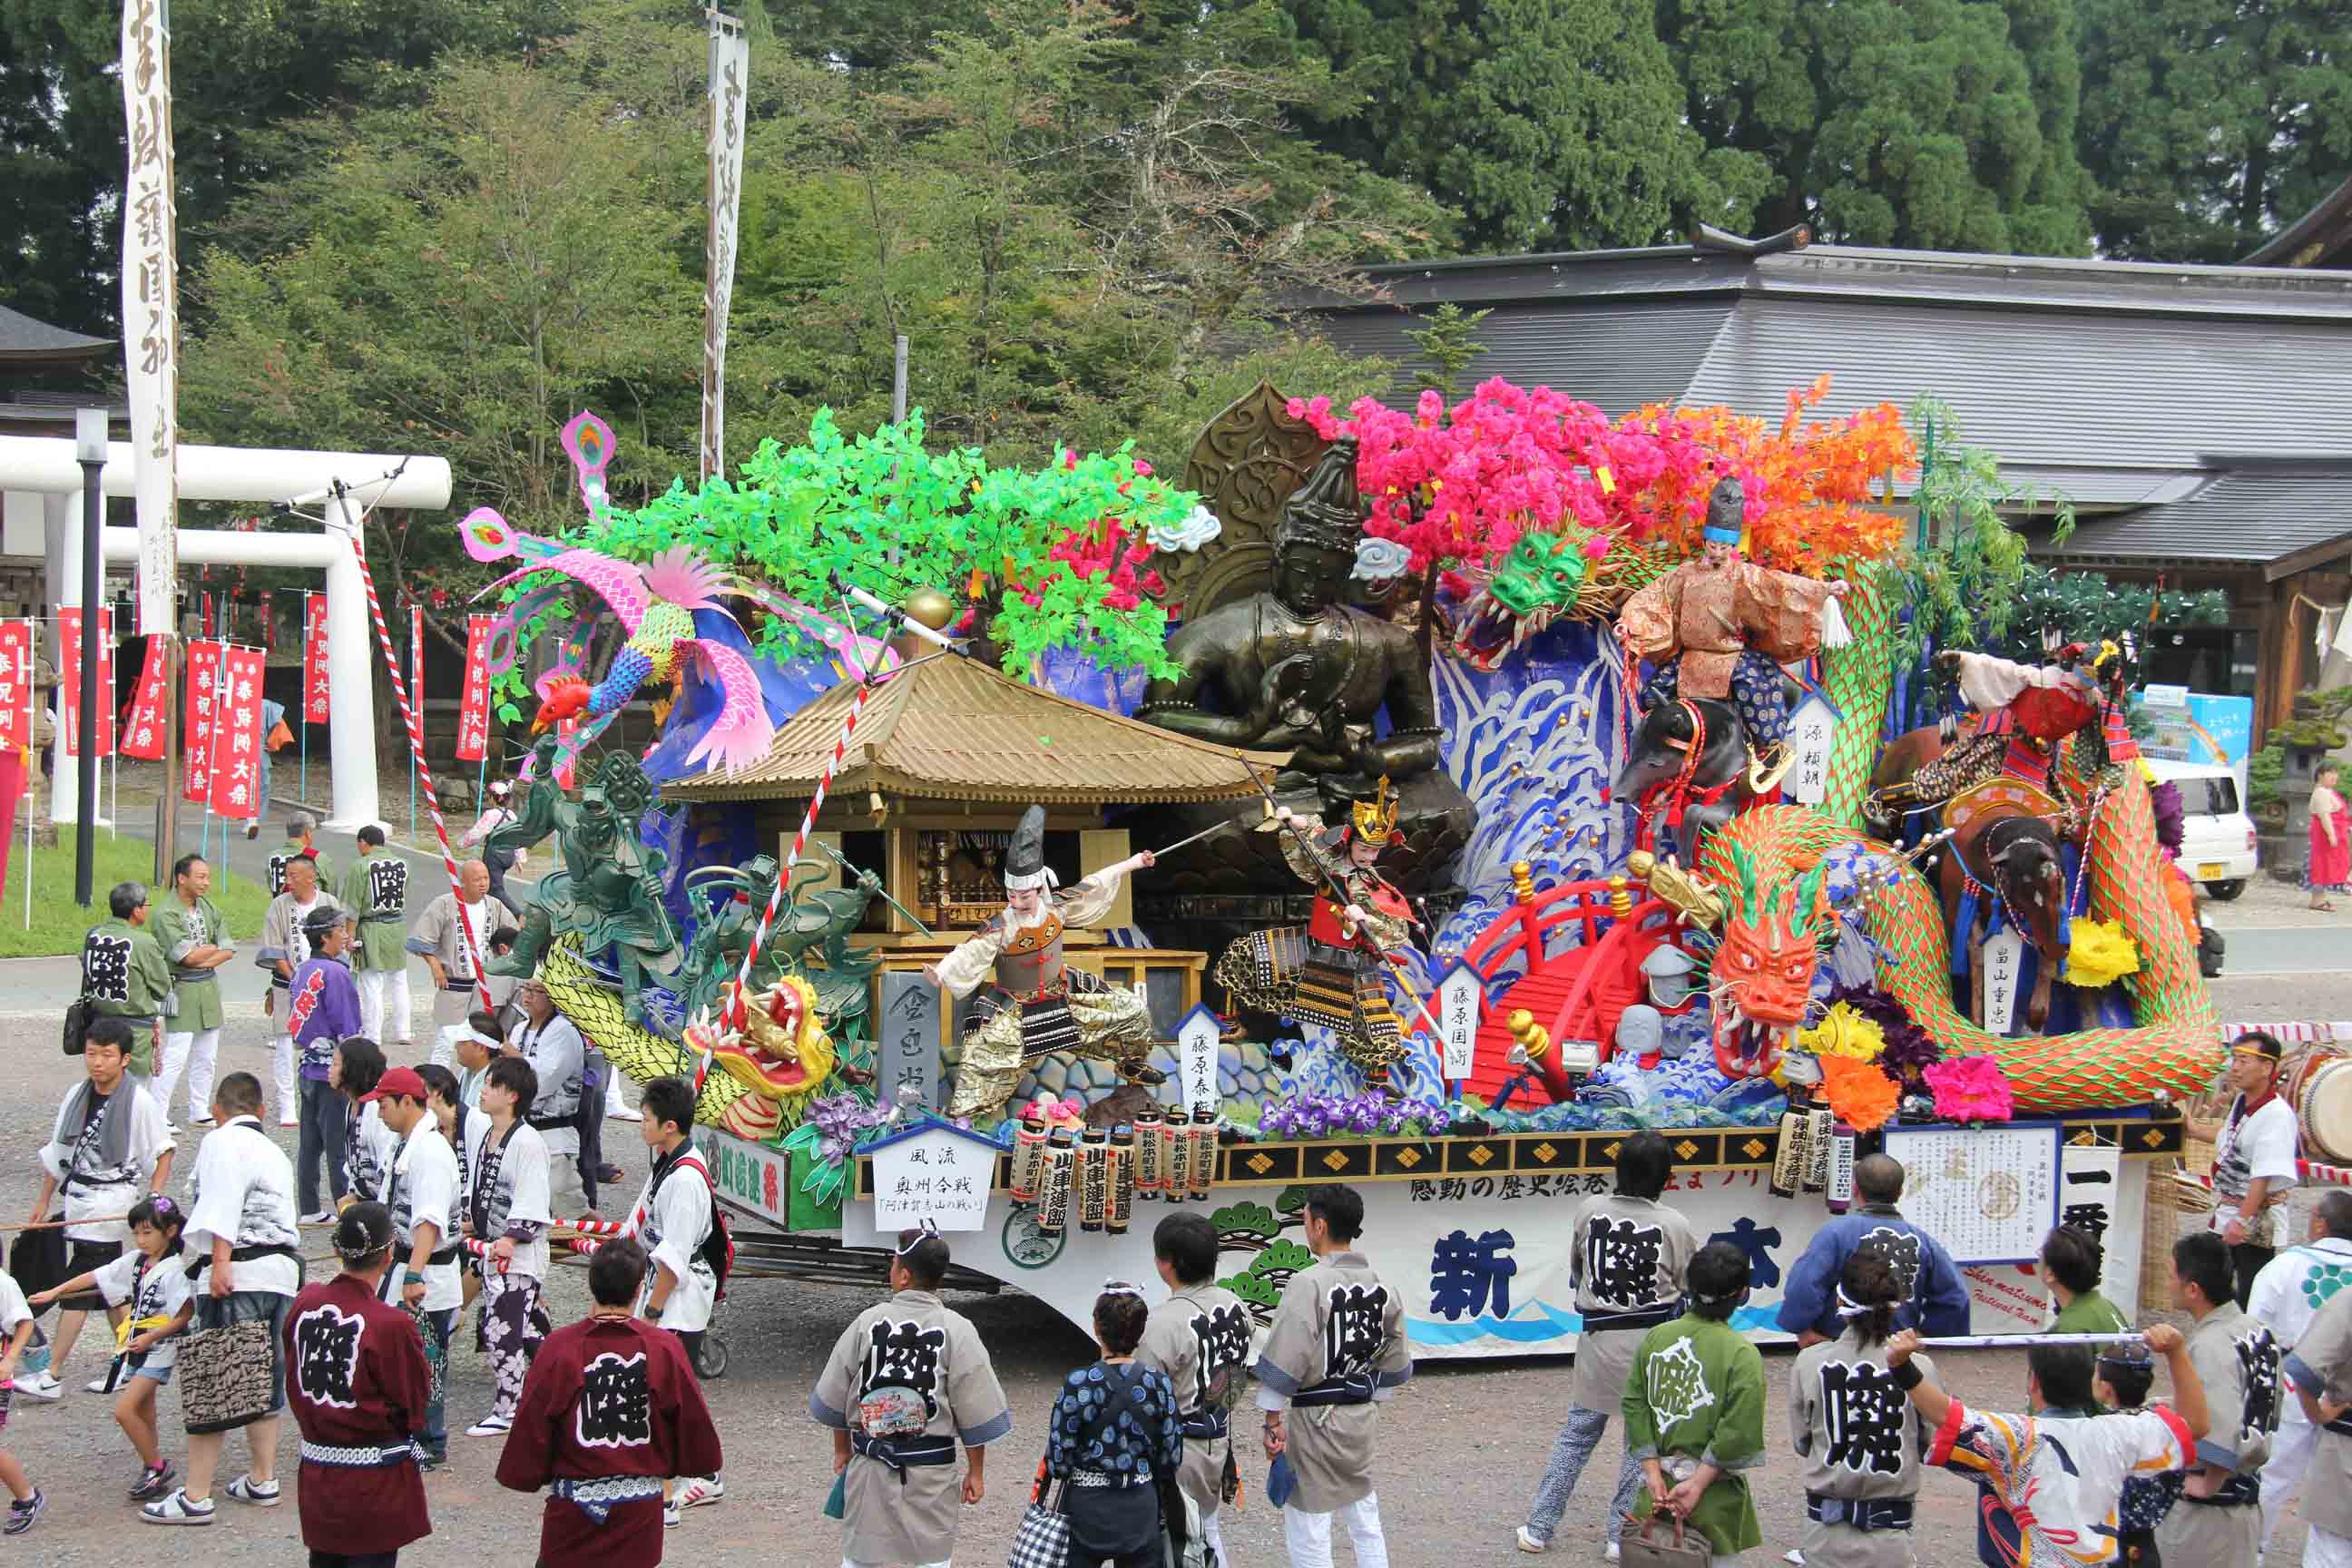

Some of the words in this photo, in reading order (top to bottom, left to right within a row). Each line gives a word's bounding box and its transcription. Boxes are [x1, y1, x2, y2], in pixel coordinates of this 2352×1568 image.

[191, 670, 212, 790] 奉祝例大祭
[909, 1147, 956, 1165] 風流
[894, 1176, 973, 1195] 奥州合戦
[1045, 1152, 1074, 1227] 山車連盟
[1085, 1147, 1107, 1221] 山車連盟
[1409, 1173, 1609, 1201] 感動の歴史絵巻
